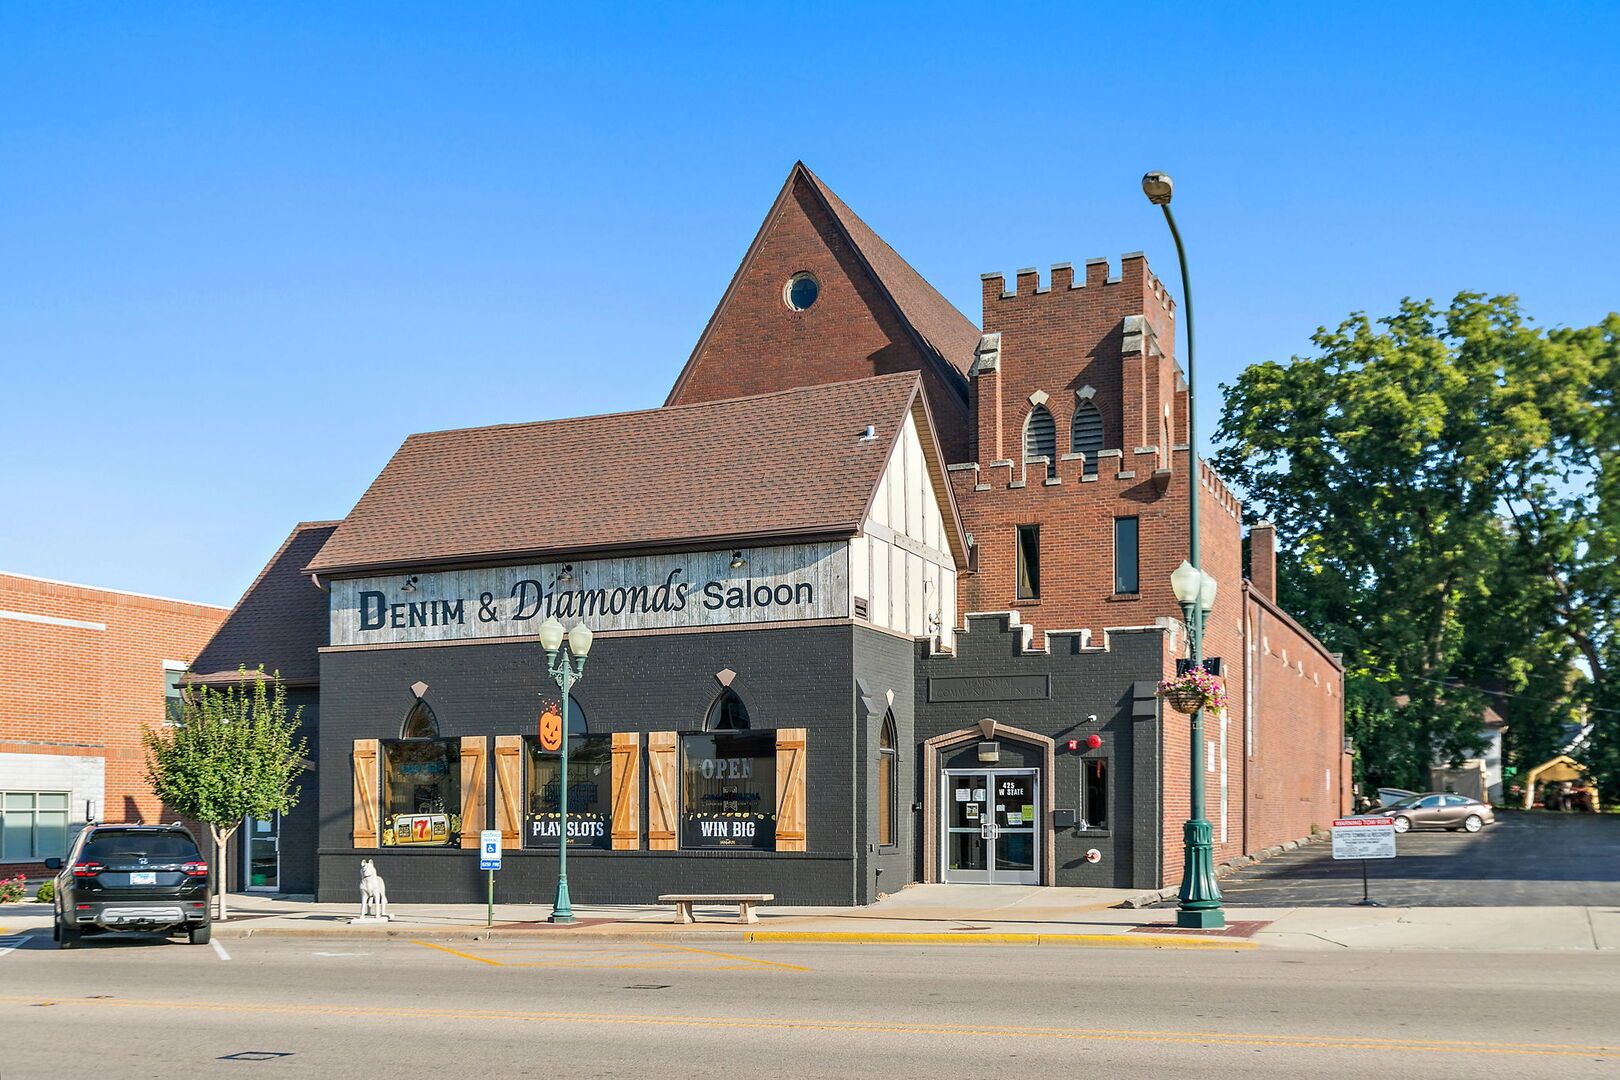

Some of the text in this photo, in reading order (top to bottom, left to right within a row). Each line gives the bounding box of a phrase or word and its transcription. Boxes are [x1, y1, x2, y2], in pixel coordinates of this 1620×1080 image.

[358, 568, 813, 632] DENIM & Diamonds Saloon
[701, 758, 754, 780] OPEN
[998, 788, 1024, 796] W STATE
[413, 819, 428, 839] 7
[533, 821, 604, 837] PLAY SLOTS
[701, 821, 756, 837] WIN BIG
